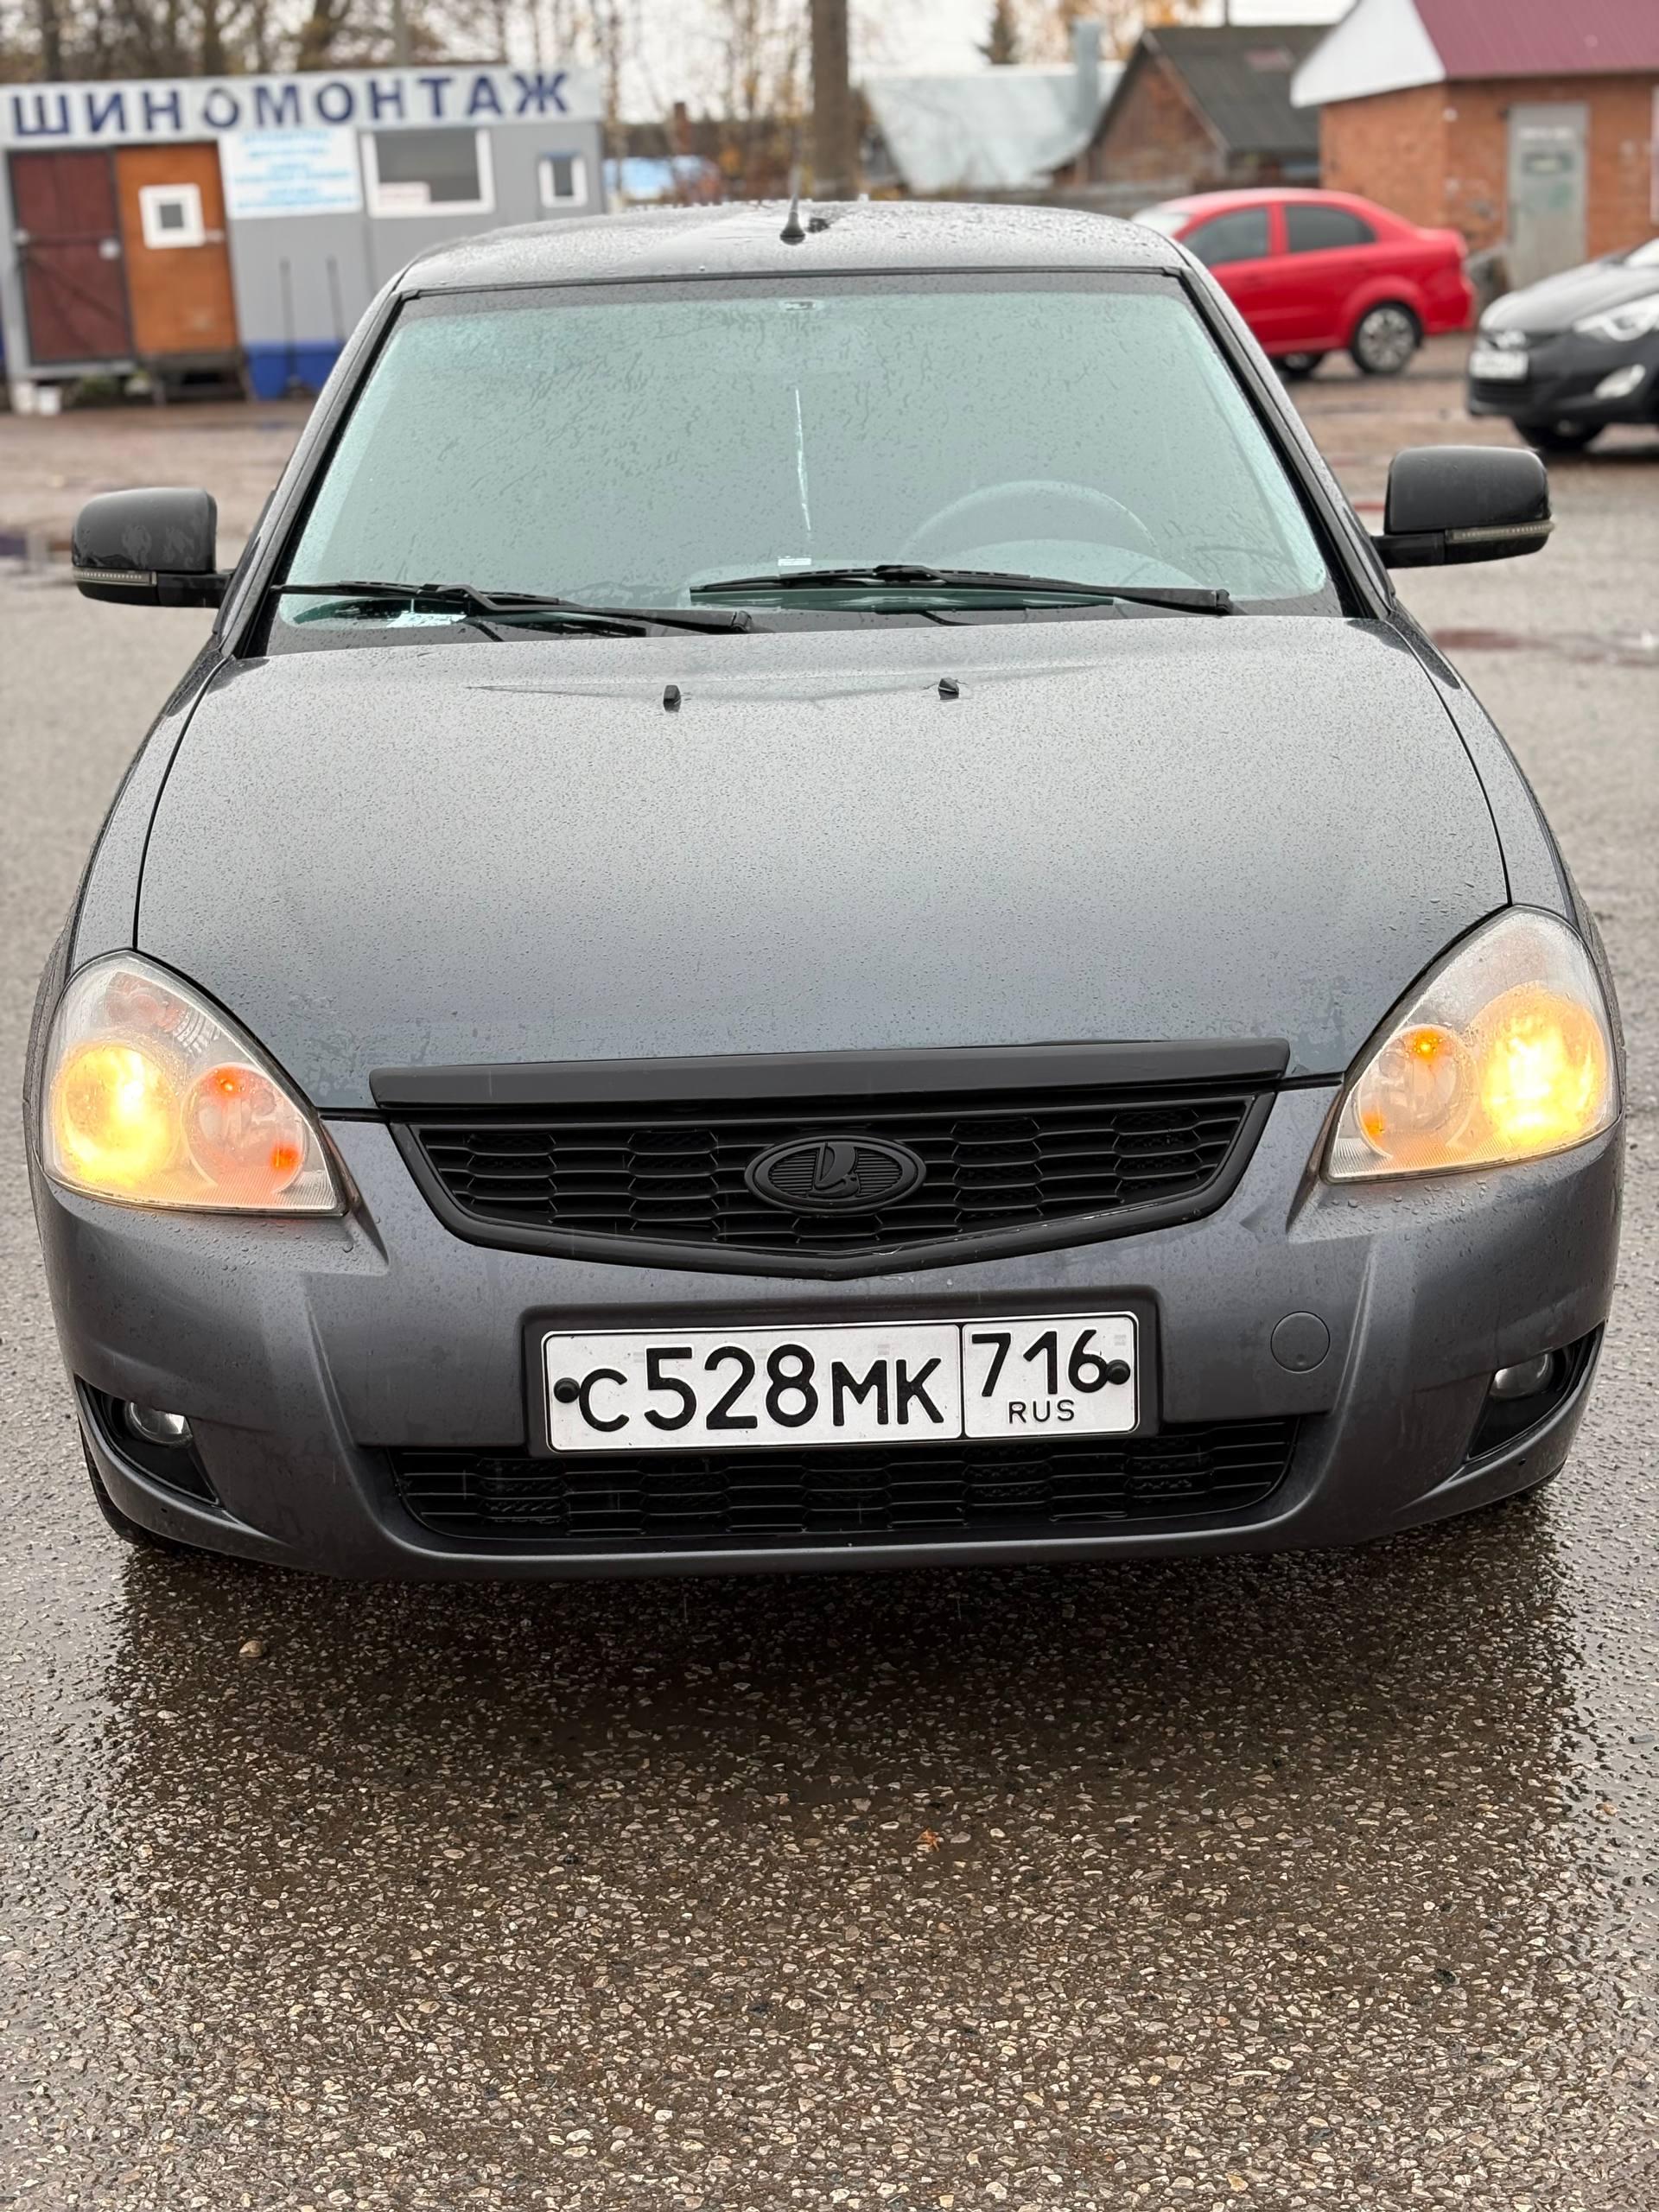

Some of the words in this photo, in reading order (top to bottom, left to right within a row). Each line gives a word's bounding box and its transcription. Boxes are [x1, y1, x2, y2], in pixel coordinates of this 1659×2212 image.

[10, 71, 571, 137] ШИНОМОНТАЖ
[970, 1329, 1109, 1398] 716
[1007, 1400, 1076, 1425] RUS
